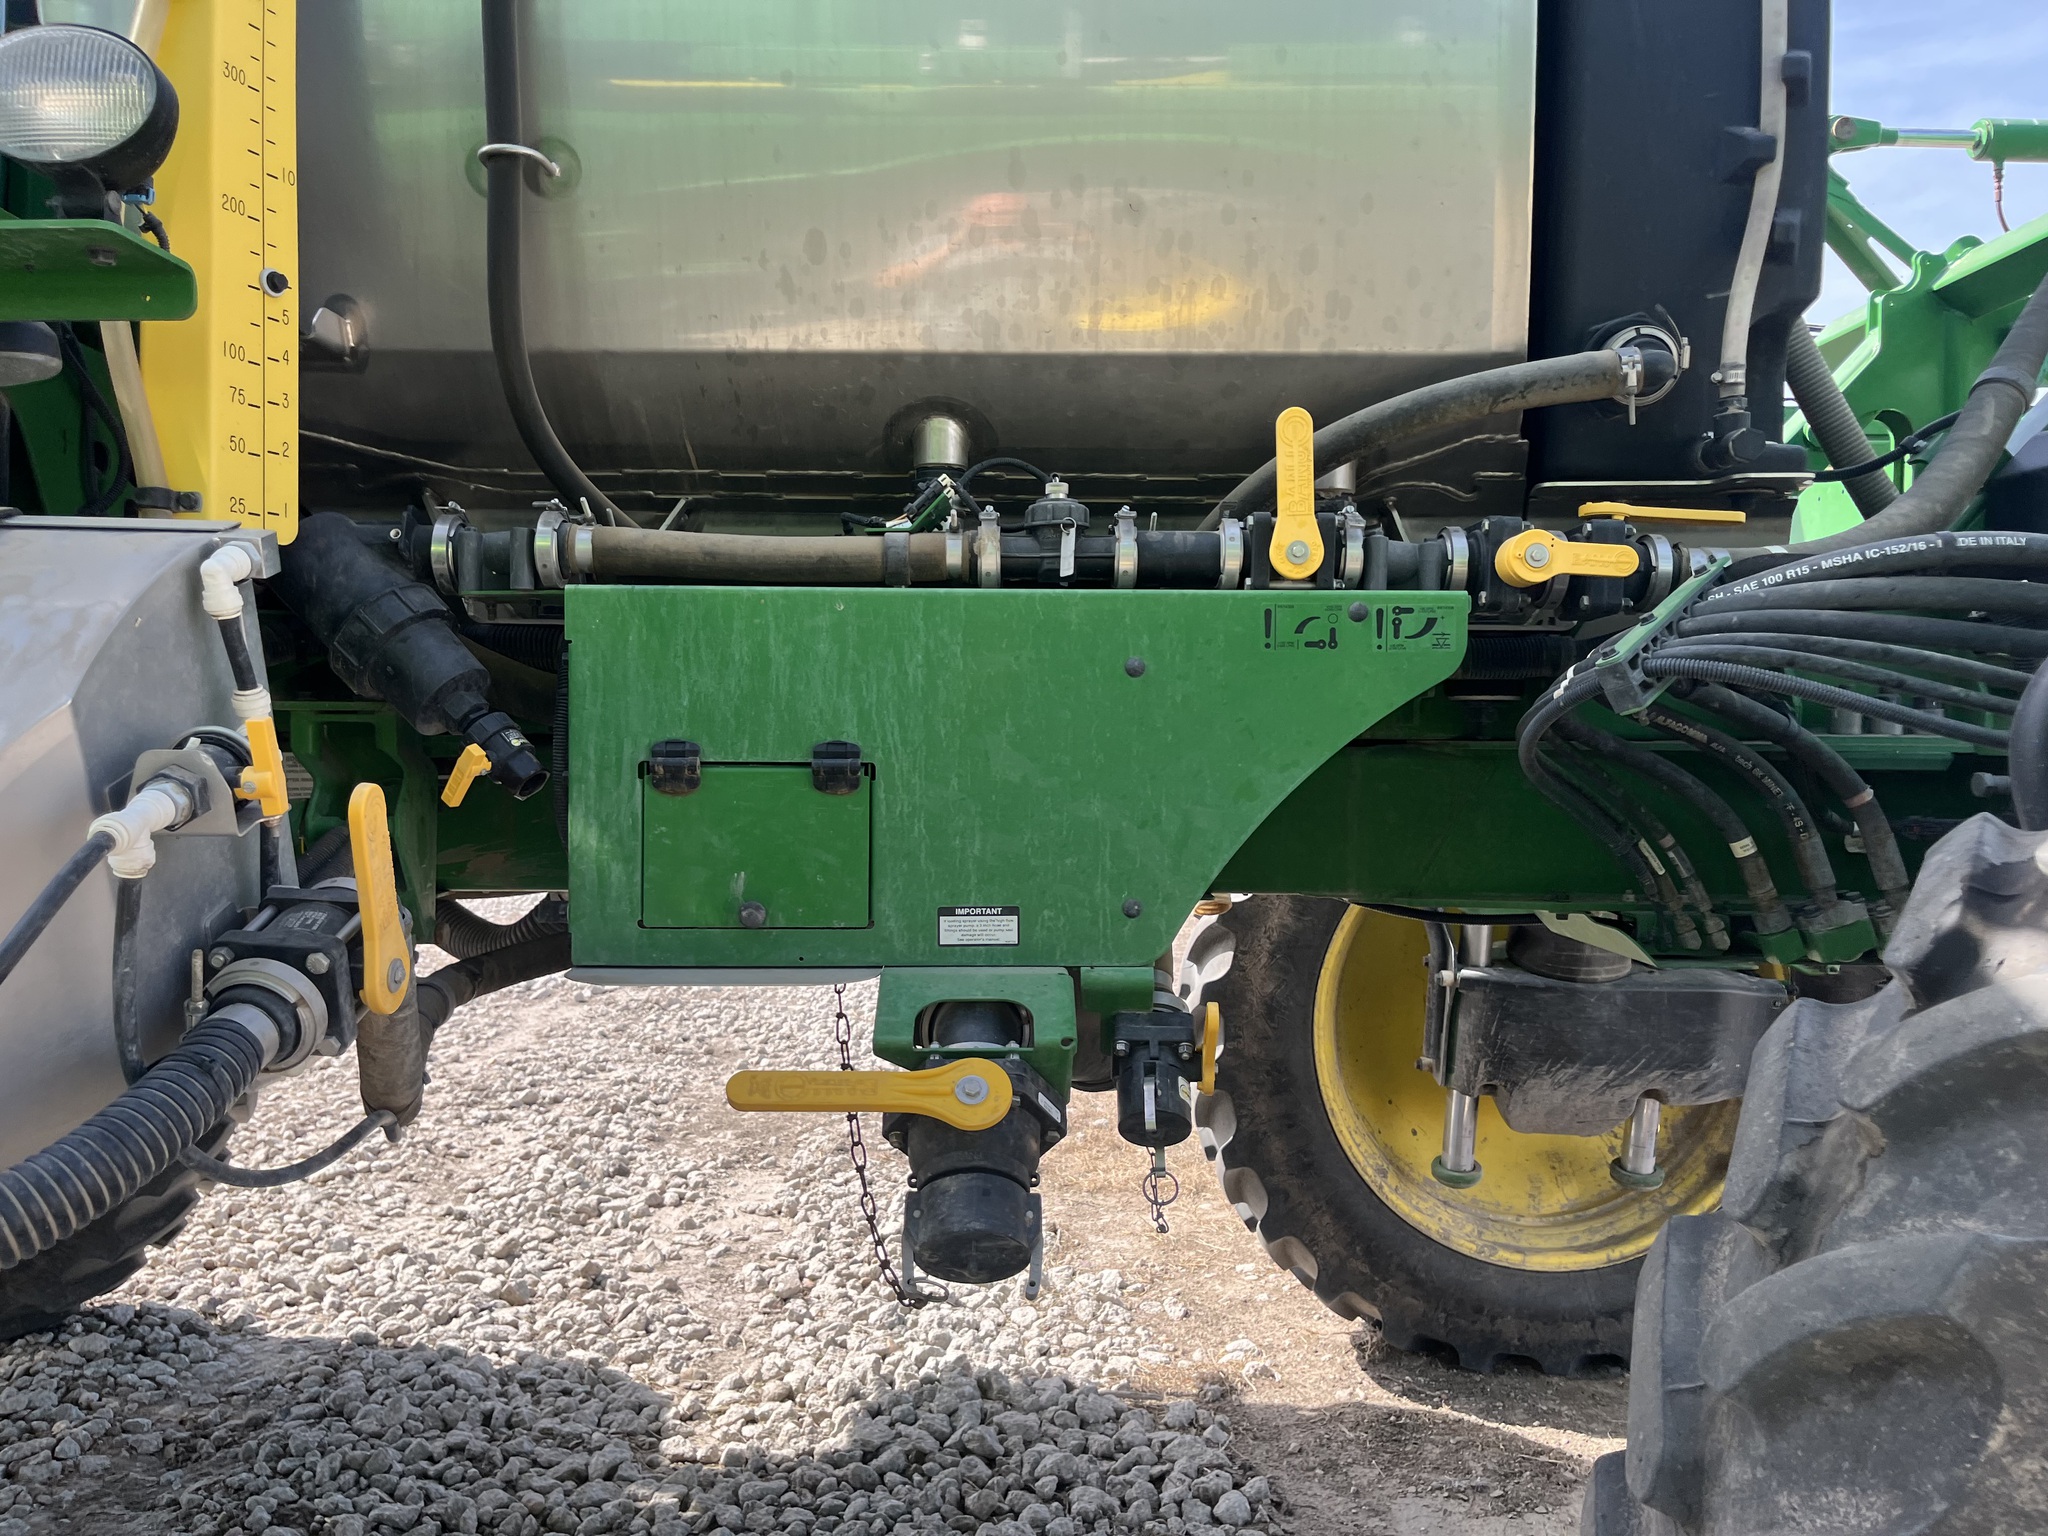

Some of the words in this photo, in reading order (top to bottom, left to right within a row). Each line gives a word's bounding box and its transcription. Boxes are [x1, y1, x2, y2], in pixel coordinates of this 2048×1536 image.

[222, 61, 246, 86] 300
[282, 167, 296, 187] 10
[221, 194, 246, 217] 200
[281, 308, 290, 326] 5
[223, 341, 246, 362] 100
[282, 349, 290, 366] 4
[229, 386, 246, 406] 75
[281, 392, 290, 409] 3
[229, 434, 246, 454] 50
[282, 441, 290, 458] 2
[229, 496, 246, 515] 25
[1733, 580, 1759, 595] SAE
[1761, 573, 1783, 587] 100
[1786, 565, 1810, 580] R15
[1821, 552, 1862, 570] MSHA
[1865, 541, 1927, 559] IC-152/16
[1979, 536, 1993, 546] IN
[1995, 536, 2027, 546] ITALY
[955, 907, 1003, 915] IMPORTANT
